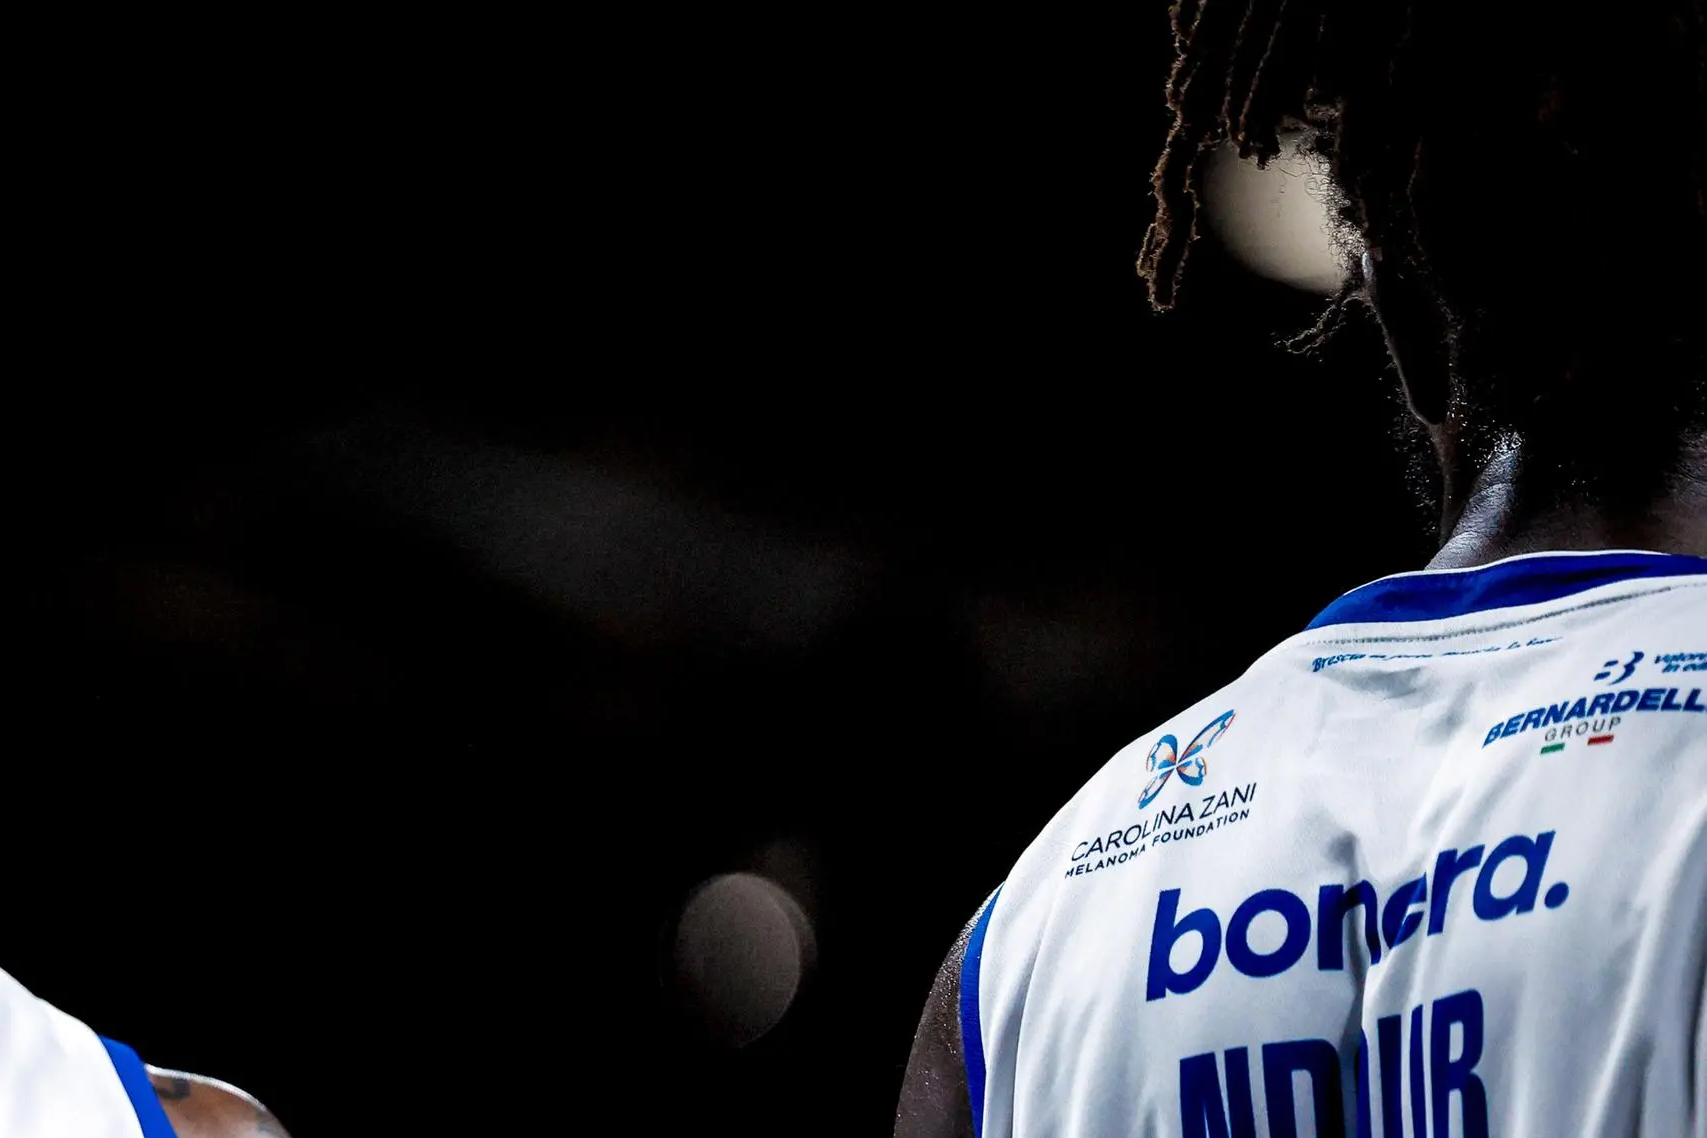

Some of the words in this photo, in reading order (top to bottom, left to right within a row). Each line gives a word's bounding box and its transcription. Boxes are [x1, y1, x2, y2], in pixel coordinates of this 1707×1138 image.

[1481, 687, 1707, 749] BERNARDELL
[1544, 716, 1622, 742] GROUP
[1064, 844, 1146, 880] MELANOMA
[1151, 808, 1250, 848] FOUNDATION
[1071, 802, 1194, 862] CAROLINA
[1199, 782, 1258, 819] ZANI
